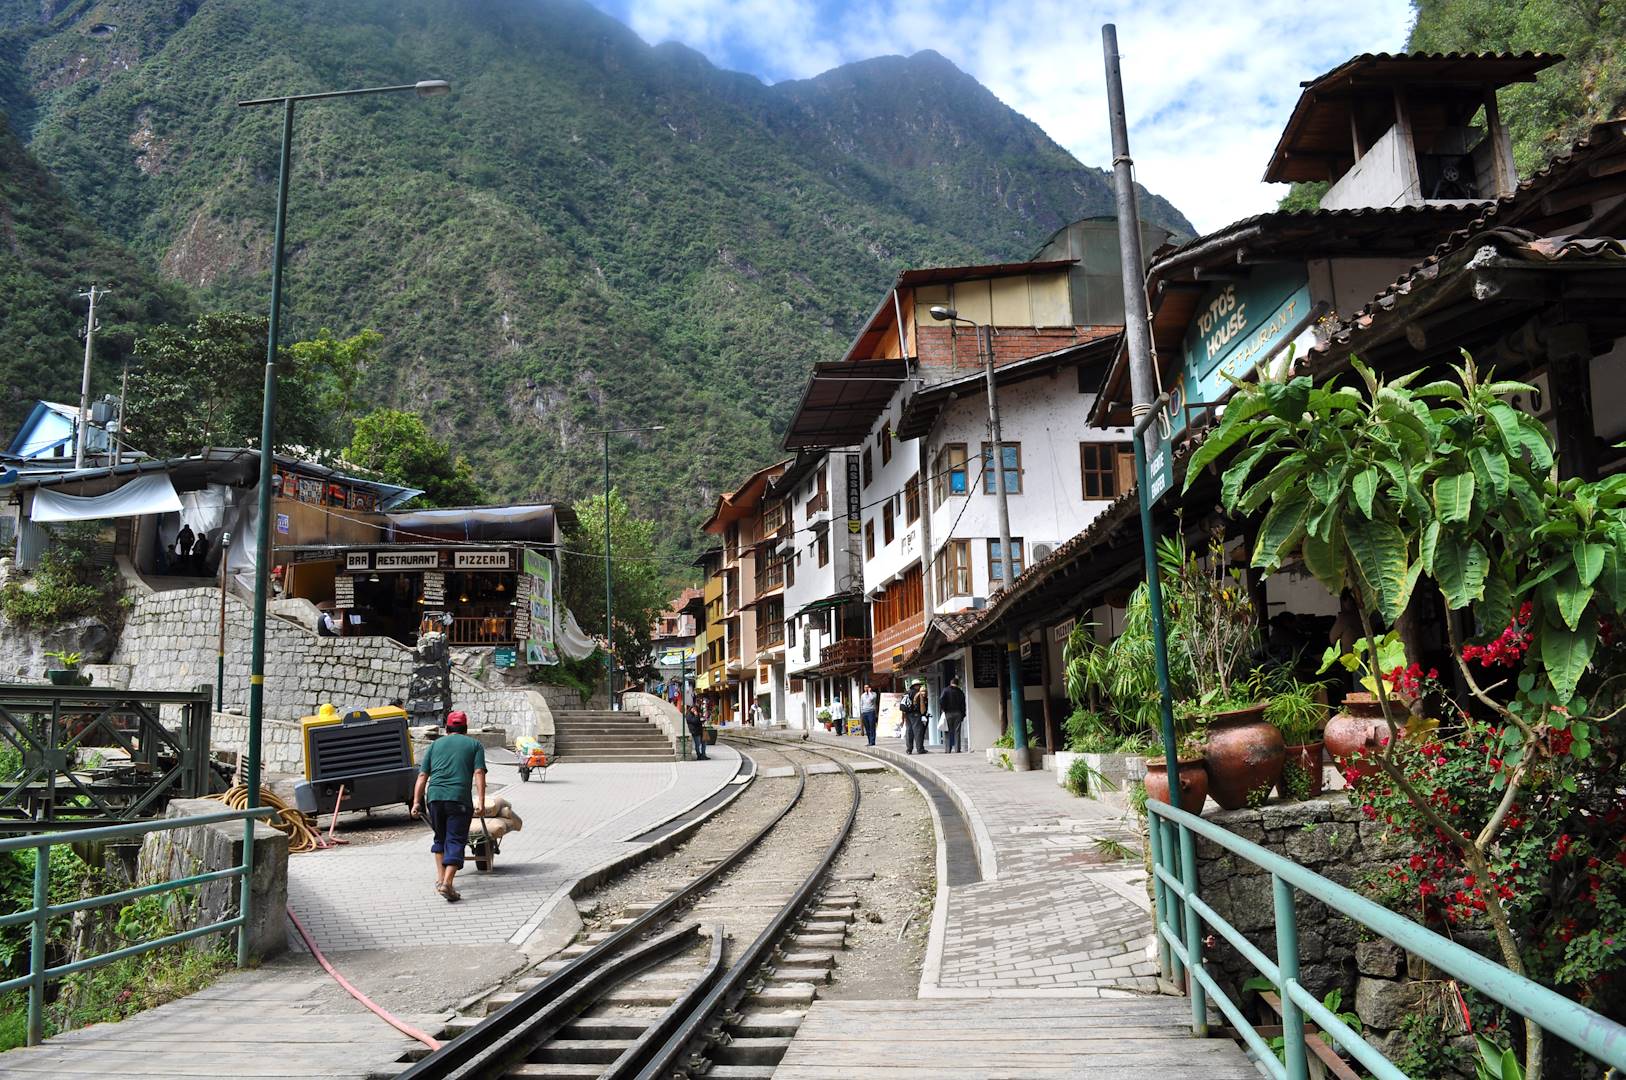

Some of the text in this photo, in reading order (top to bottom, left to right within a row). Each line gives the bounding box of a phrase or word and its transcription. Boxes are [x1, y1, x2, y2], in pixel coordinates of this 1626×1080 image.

[1198, 284, 1235, 338] TOTO'S
[1206, 303, 1247, 360] HOUSE
[848, 456, 859, 520] MASSAGES
[348, 555, 506, 566] BAR RESTAURANT PIZZERIA
